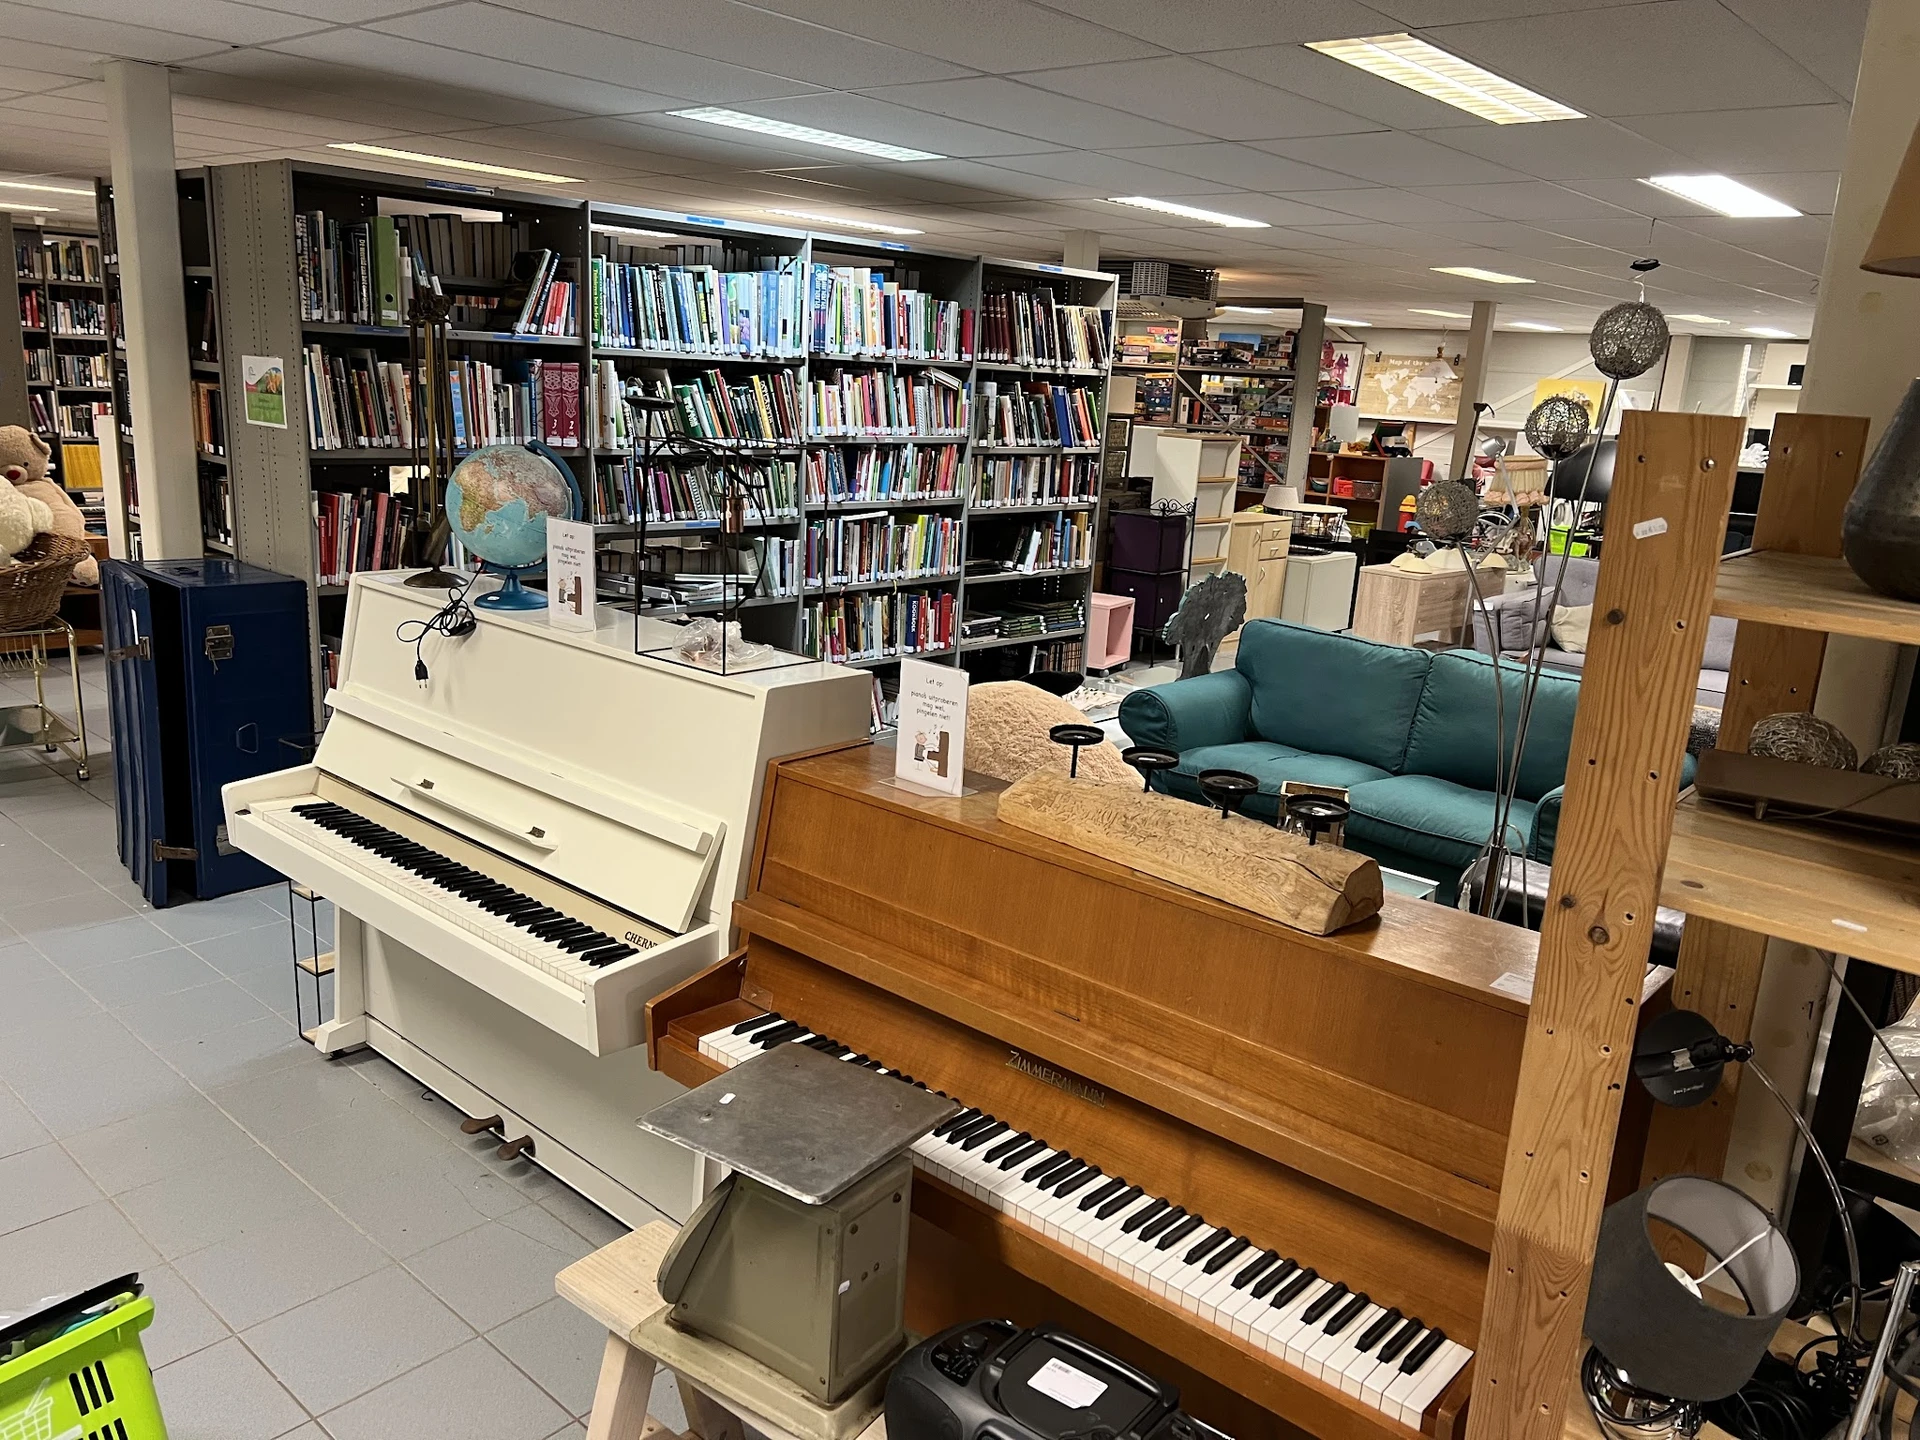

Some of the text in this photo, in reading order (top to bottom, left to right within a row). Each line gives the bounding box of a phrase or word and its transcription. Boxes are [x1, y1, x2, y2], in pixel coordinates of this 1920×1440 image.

[1389, 358, 1403, 367] Map
[552, 419, 557, 429] 3
[569, 420, 574, 430] 2
[925, 677, 935, 685] Let
[928, 694, 959, 707] uitproberen
[922, 701, 934, 710] mag
[916, 708, 938, 717] pingelen
[1005, 1050, 1106, 1108] ZIMMERMANN
